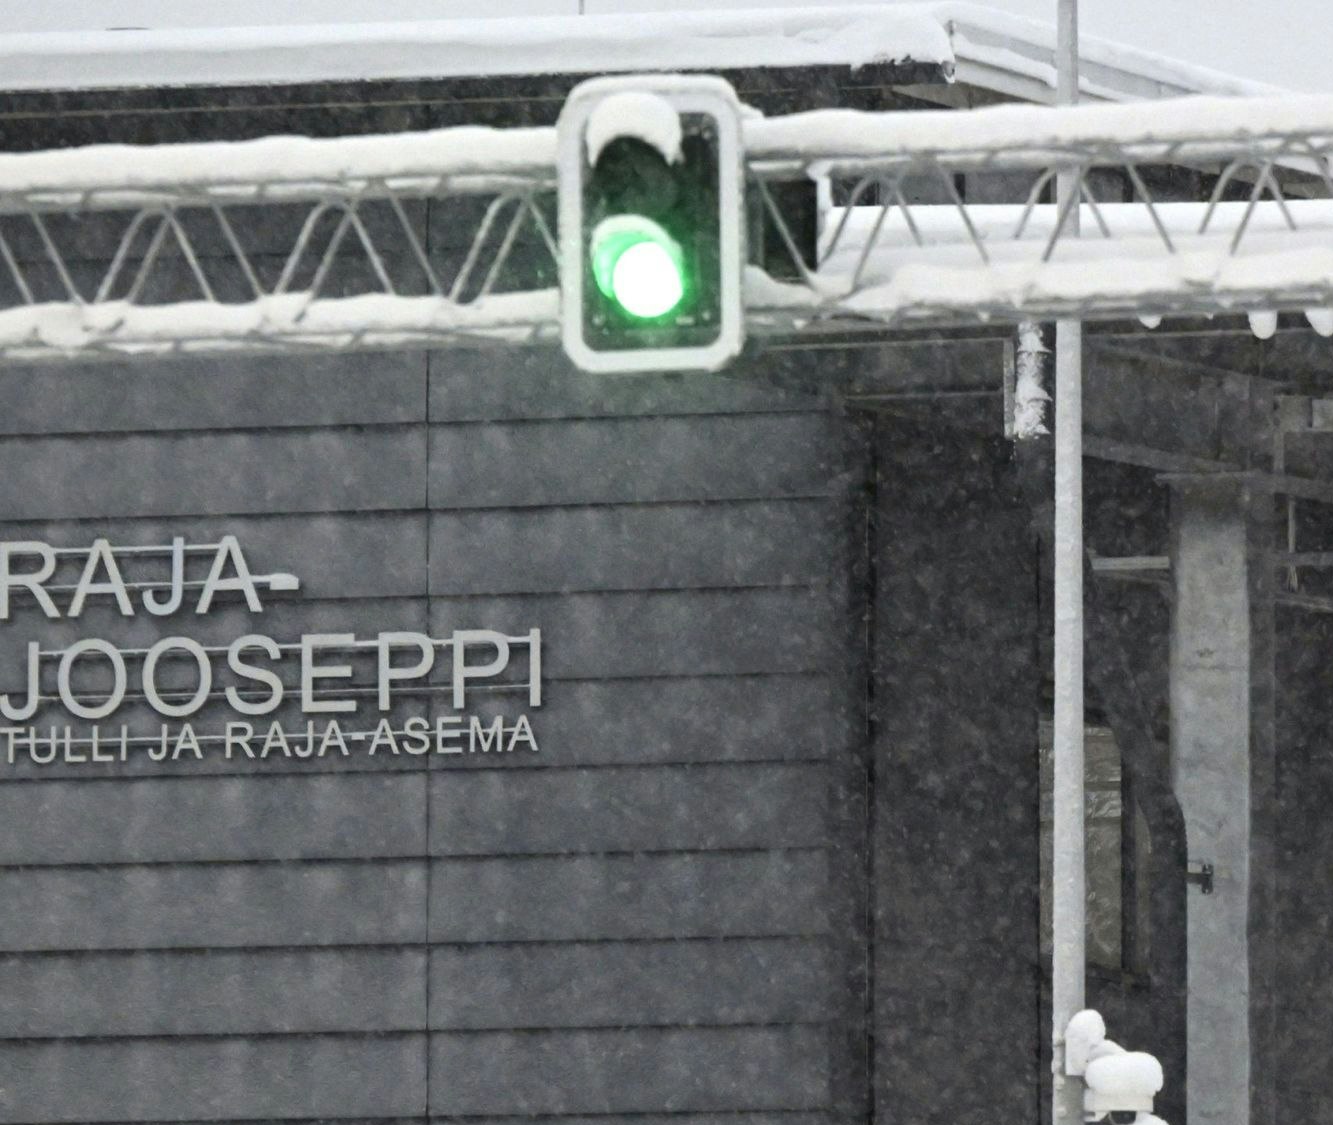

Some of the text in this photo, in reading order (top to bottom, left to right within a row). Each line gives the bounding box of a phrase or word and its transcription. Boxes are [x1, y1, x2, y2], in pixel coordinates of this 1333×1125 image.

[0, 535, 299, 618] RAJA-
[0, 628, 541, 720] JOOSEPPI
[0, 714, 538, 764] TULLI JA RAJA-ASEMA
